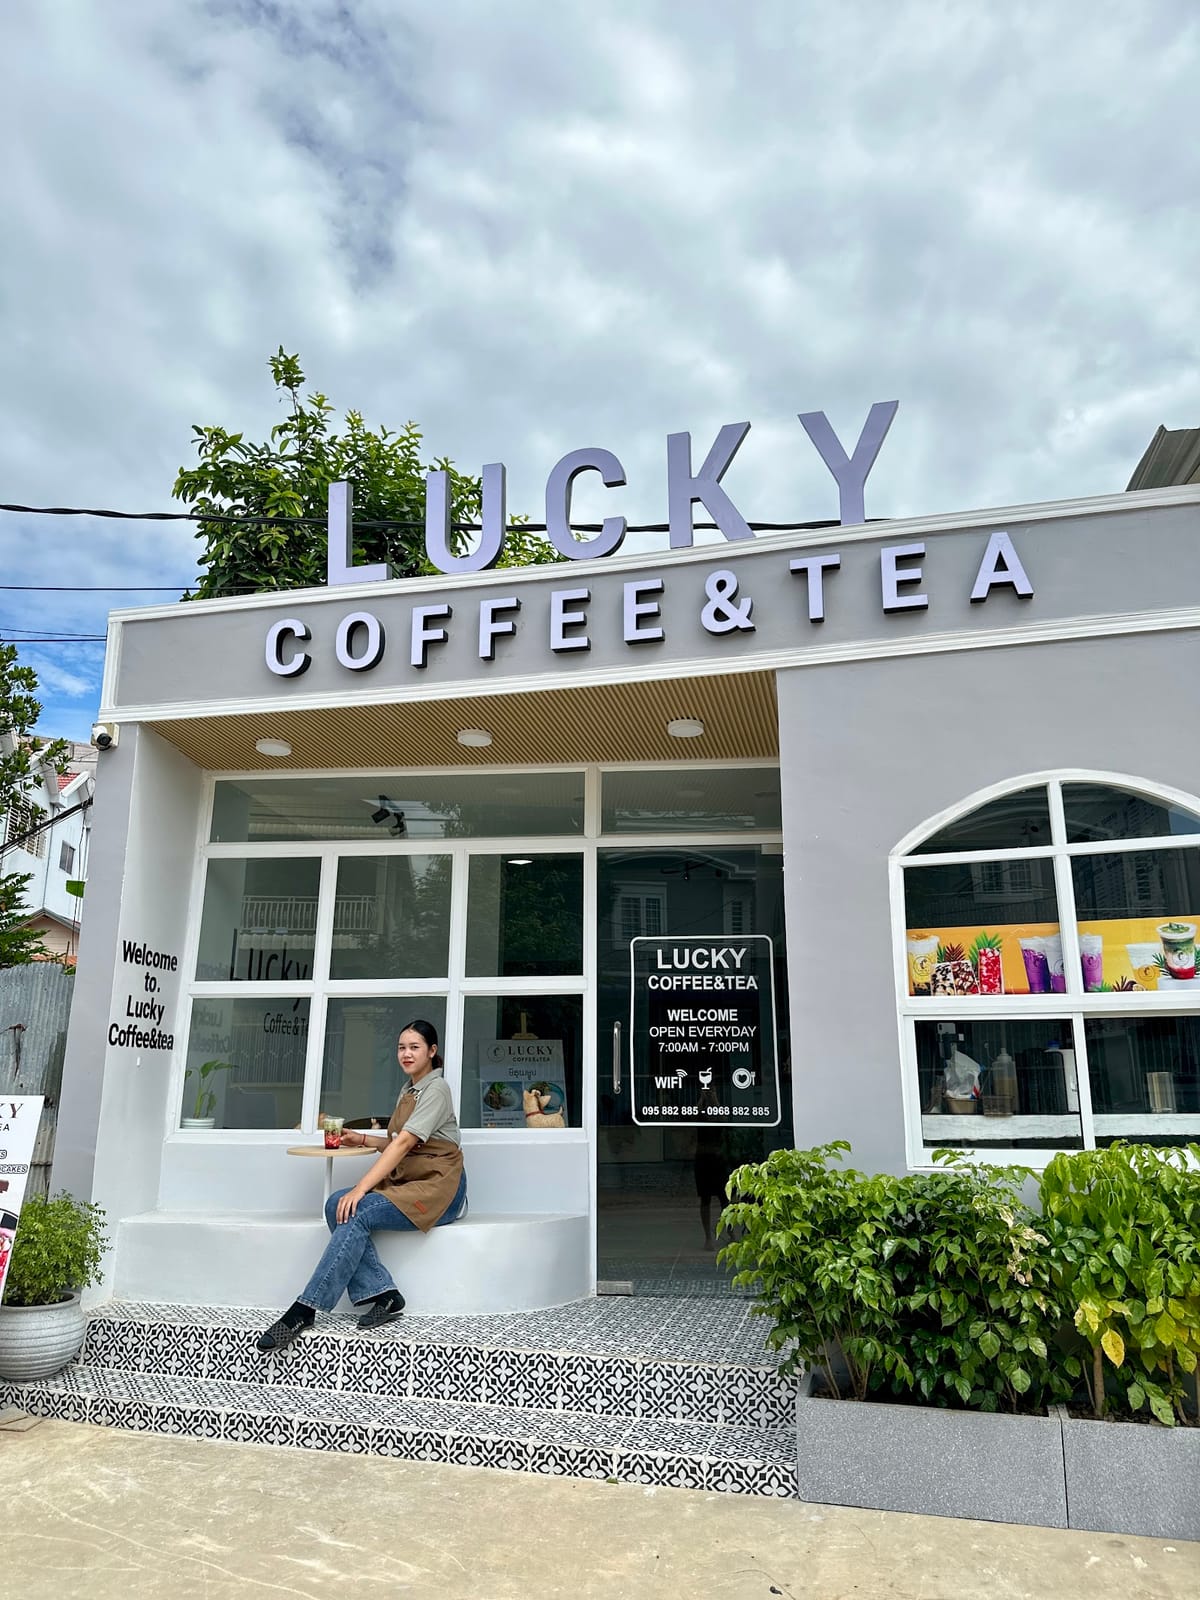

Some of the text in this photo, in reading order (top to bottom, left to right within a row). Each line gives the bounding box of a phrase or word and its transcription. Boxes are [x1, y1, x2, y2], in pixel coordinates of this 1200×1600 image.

[327, 400, 899, 586] LUCKY
[122, 939, 178, 972] Welcome
[656, 947, 747, 969] LUCKY
[647, 974, 759, 991] COFFEE&TEA
[126, 994, 165, 1026] Lucky
[667, 1008, 739, 1022] WELCOME
[263, 1012, 309, 1037] Coffee&T
[649, 1025, 757, 1038] OPEN EVERYDAY
[108, 1022, 174, 1051] Coffee&tea
[507, 1045, 554, 1056] LUCKY
[658, 1041, 699, 1053] 7:00AM
[708, 1041, 749, 1053] 7:00PM
[642, 1105, 660, 1116] 095
[661, 1105, 679, 1116] 882
[681, 1105, 699, 1116] 885
[706, 1106, 730, 1116] 0968
[732, 1106, 750, 1116] 882
[752, 1106, 770, 1116] 885
